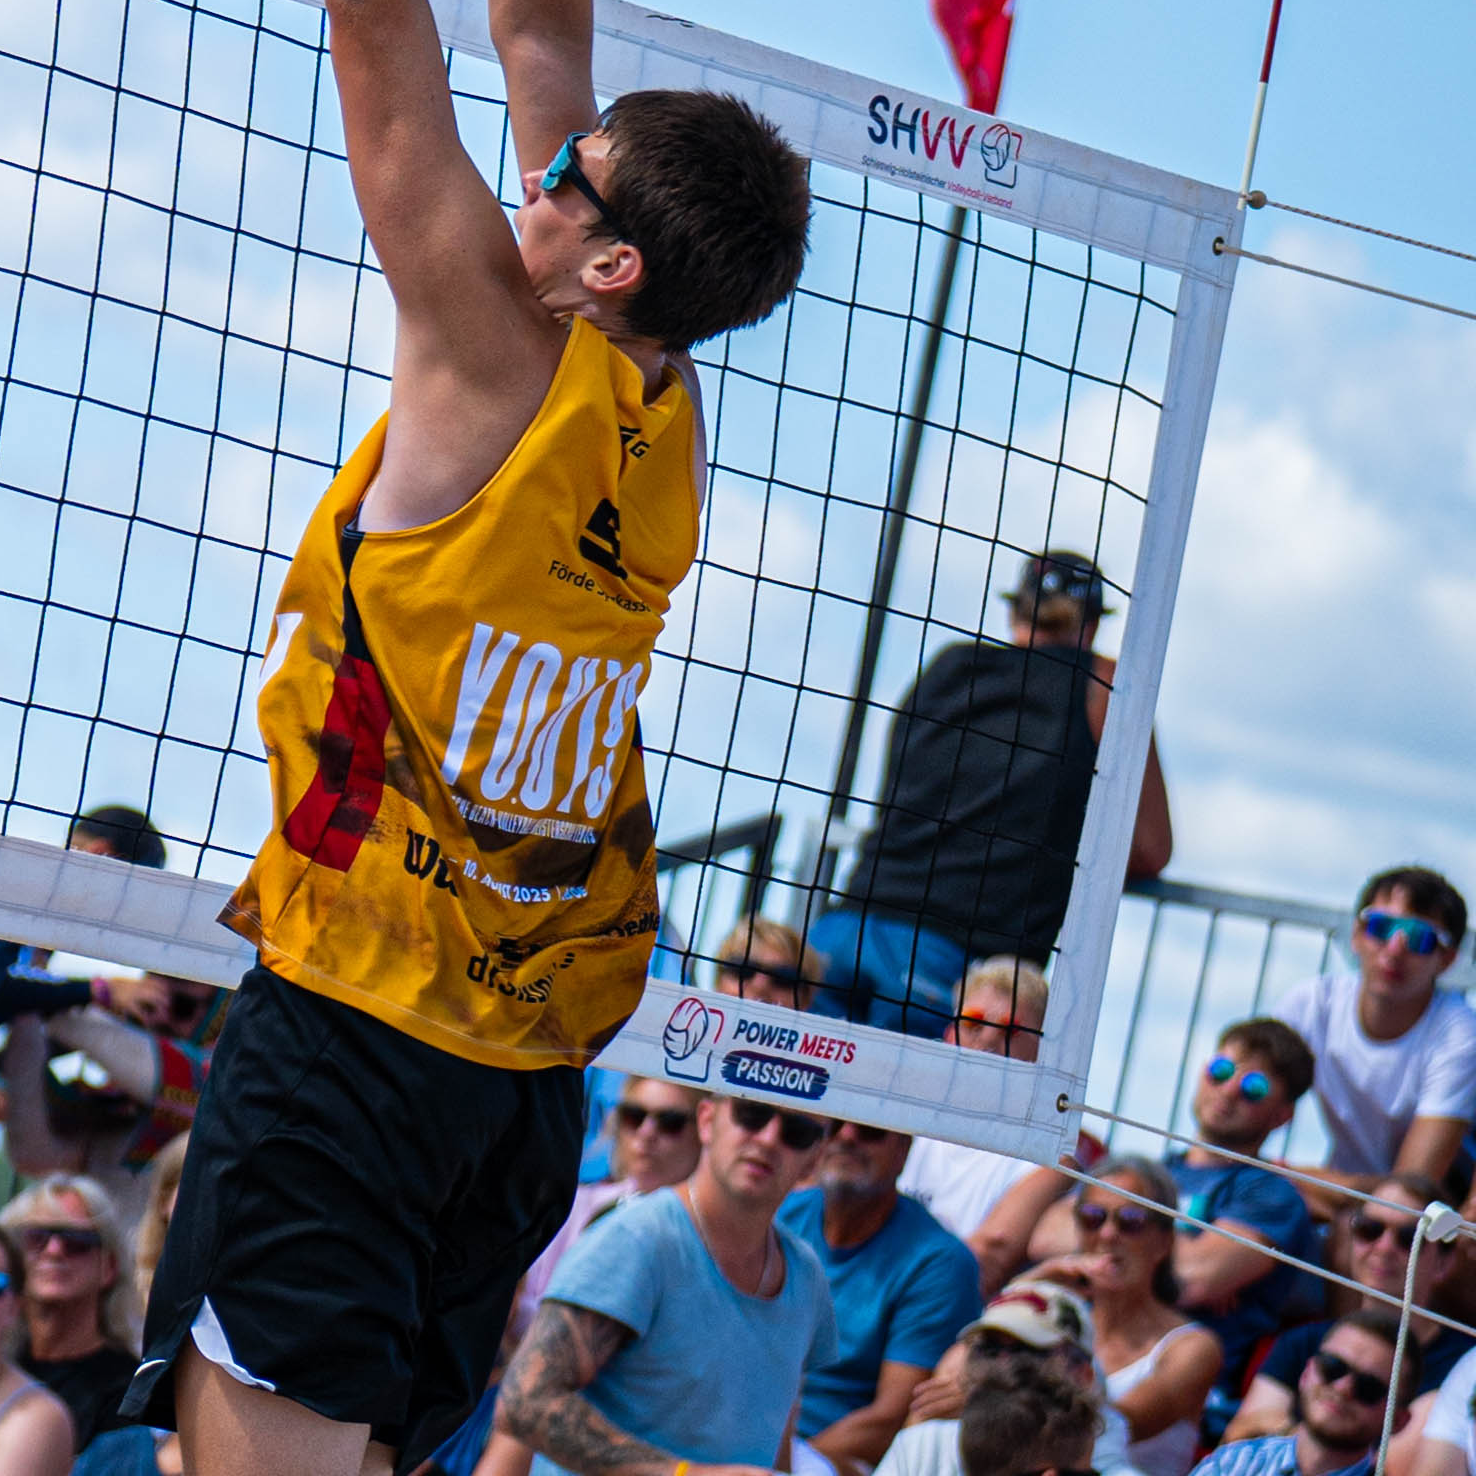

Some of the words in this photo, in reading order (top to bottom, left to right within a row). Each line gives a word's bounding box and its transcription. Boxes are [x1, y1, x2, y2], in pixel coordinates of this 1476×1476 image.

[867, 95, 975, 169] SHVV
[548, 560, 595, 591] Förde
[513, 885, 551, 903] 2025
[732, 1019, 799, 1053] POWER
[798, 1033, 857, 1064] MEETS
[736, 1058, 815, 1092] PASSION
